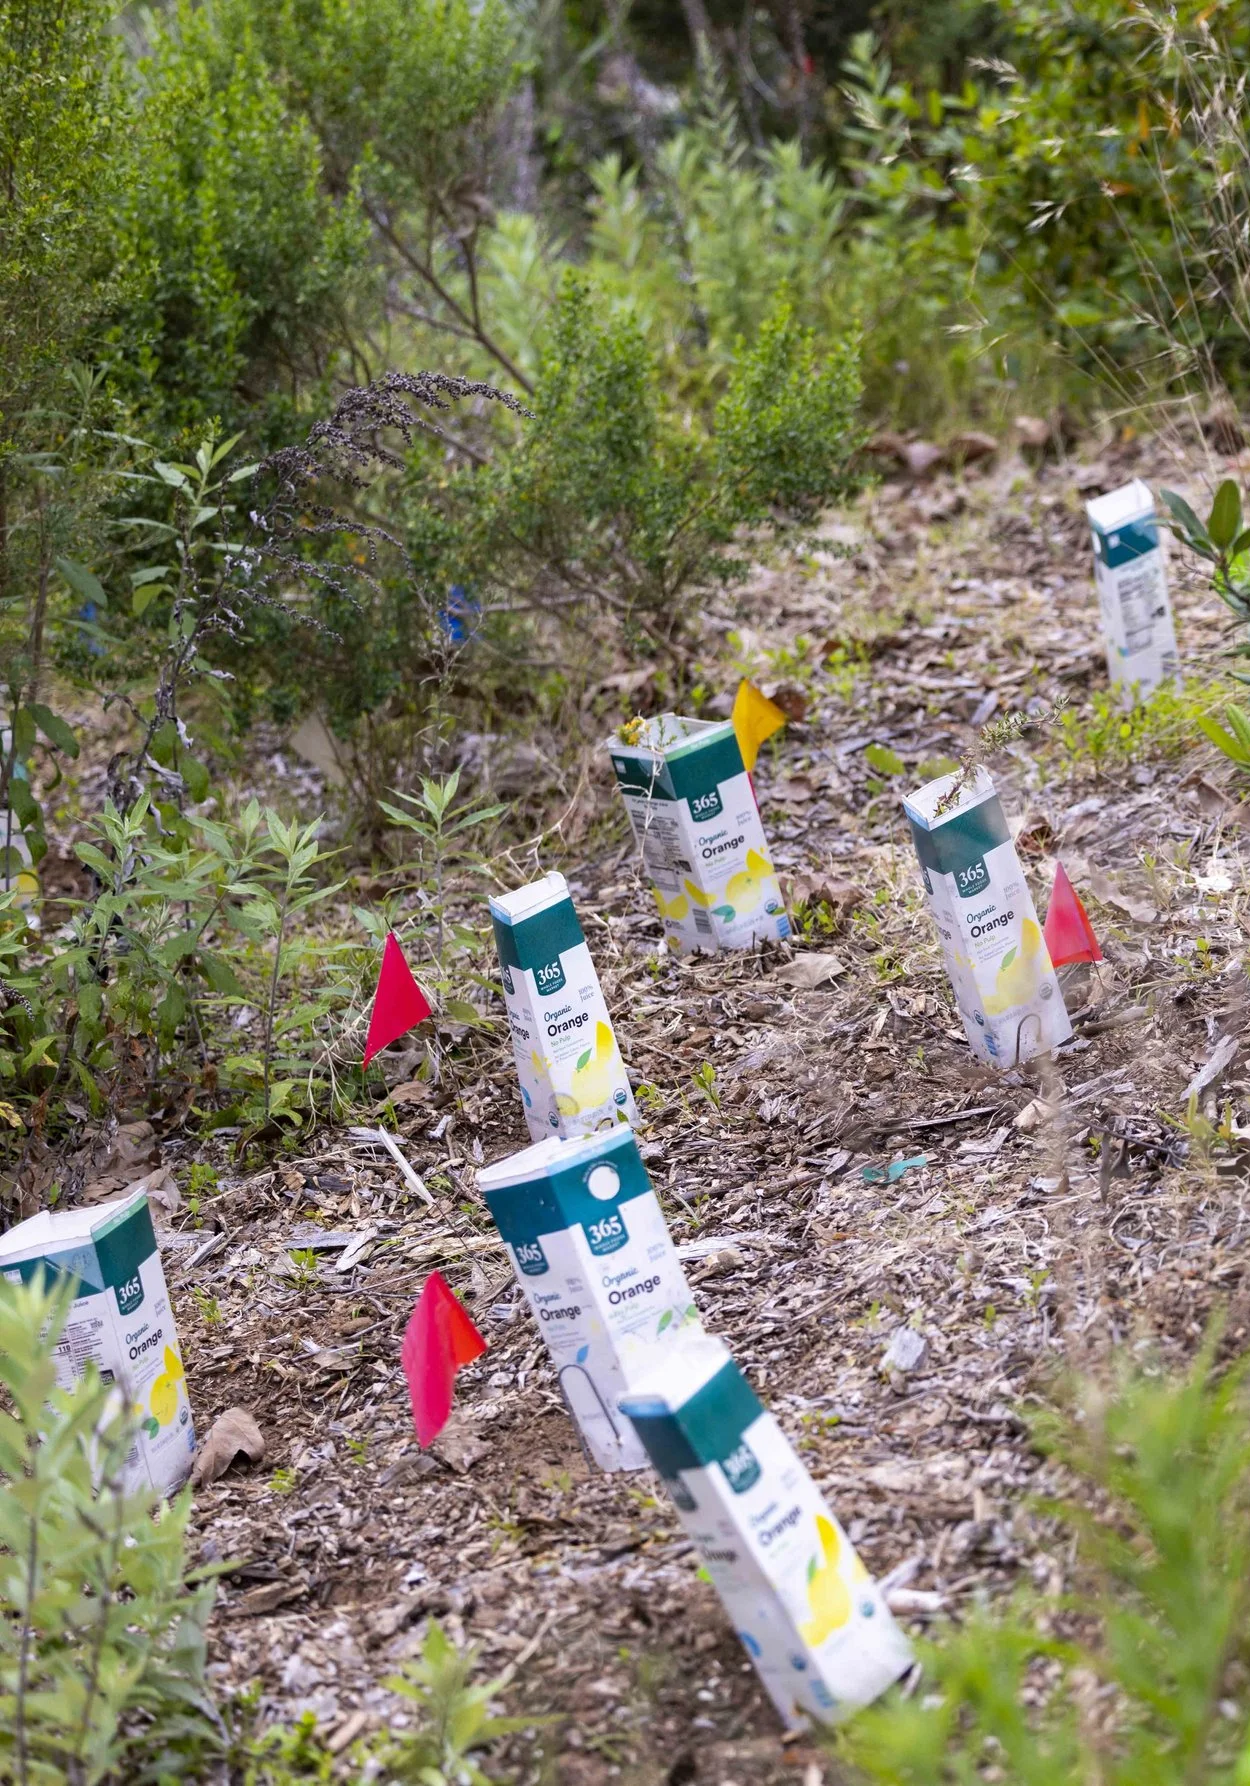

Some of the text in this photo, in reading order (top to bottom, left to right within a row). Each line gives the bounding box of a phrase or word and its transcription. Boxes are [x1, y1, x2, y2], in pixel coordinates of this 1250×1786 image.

[691, 792, 719, 814] 365
[698, 829, 728, 848] Organic
[701, 834, 745, 859] Orange
[958, 862, 985, 888] 365
[961, 883, 975, 894] WHOLE
[1004, 888, 1020, 901] Juice
[966, 904, 997, 924] Organic
[970, 909, 1015, 939] Orange
[974, 941, 984, 949] No
[536, 961, 561, 986] 365
[579, 991, 595, 1003] Juice
[543, 1004, 573, 1024] Organic
[547, 1011, 589, 1037] Orange
[550, 1040, 559, 1048] No
[588, 1215, 623, 1246] 365
[516, 1243, 543, 1265] 365
[602, 1266, 639, 1287] Organic
[118, 1275, 141, 1304] 365
[533, 1291, 562, 1306] Organic
[608, 1274, 661, 1305] Orange
[540, 1305, 581, 1322] Orange
[125, 1322, 149, 1345] Organic
[128, 1328, 163, 1361] Orange
[58, 1344, 72, 1353] 110
[758, 1504, 802, 1546] Orange
